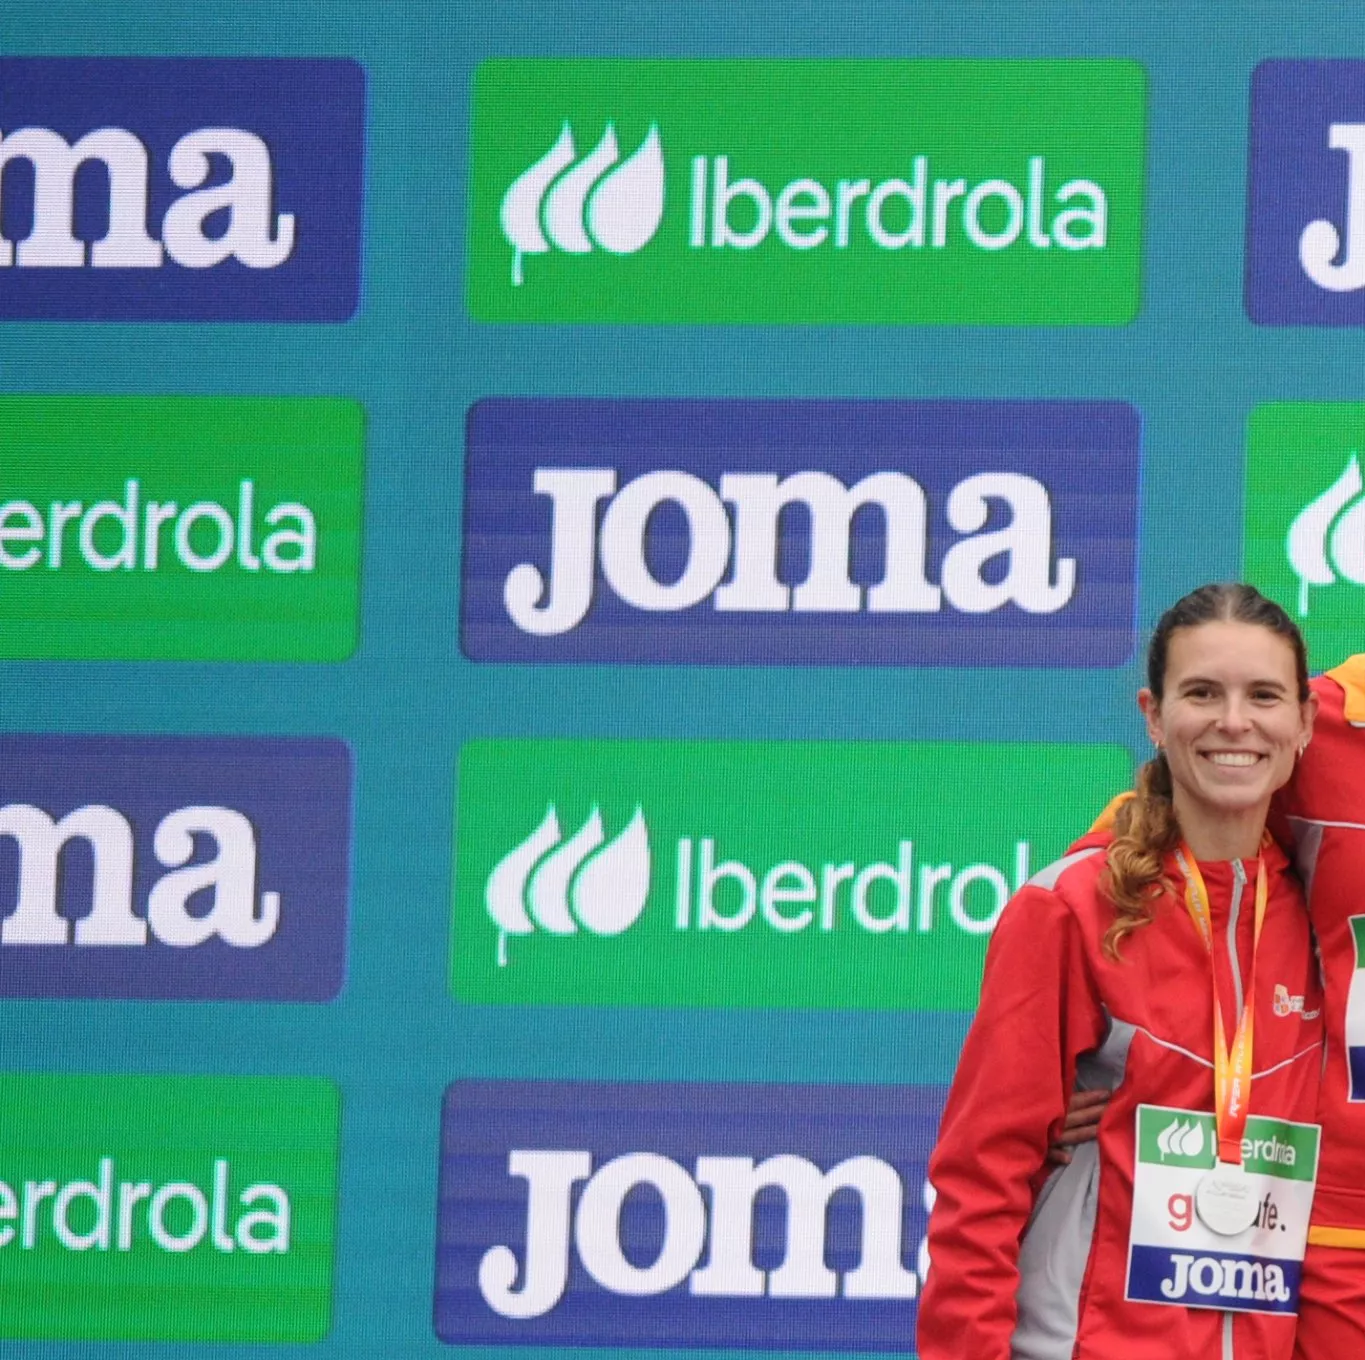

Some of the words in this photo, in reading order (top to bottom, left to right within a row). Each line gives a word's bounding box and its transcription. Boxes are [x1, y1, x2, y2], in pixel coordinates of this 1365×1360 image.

[690, 155, 1107, 250] Iberdrola
[503, 468, 1076, 635] Joma
[478, 1150, 936, 1319] Jom
[1161, 1255, 1290, 1303] Joma
